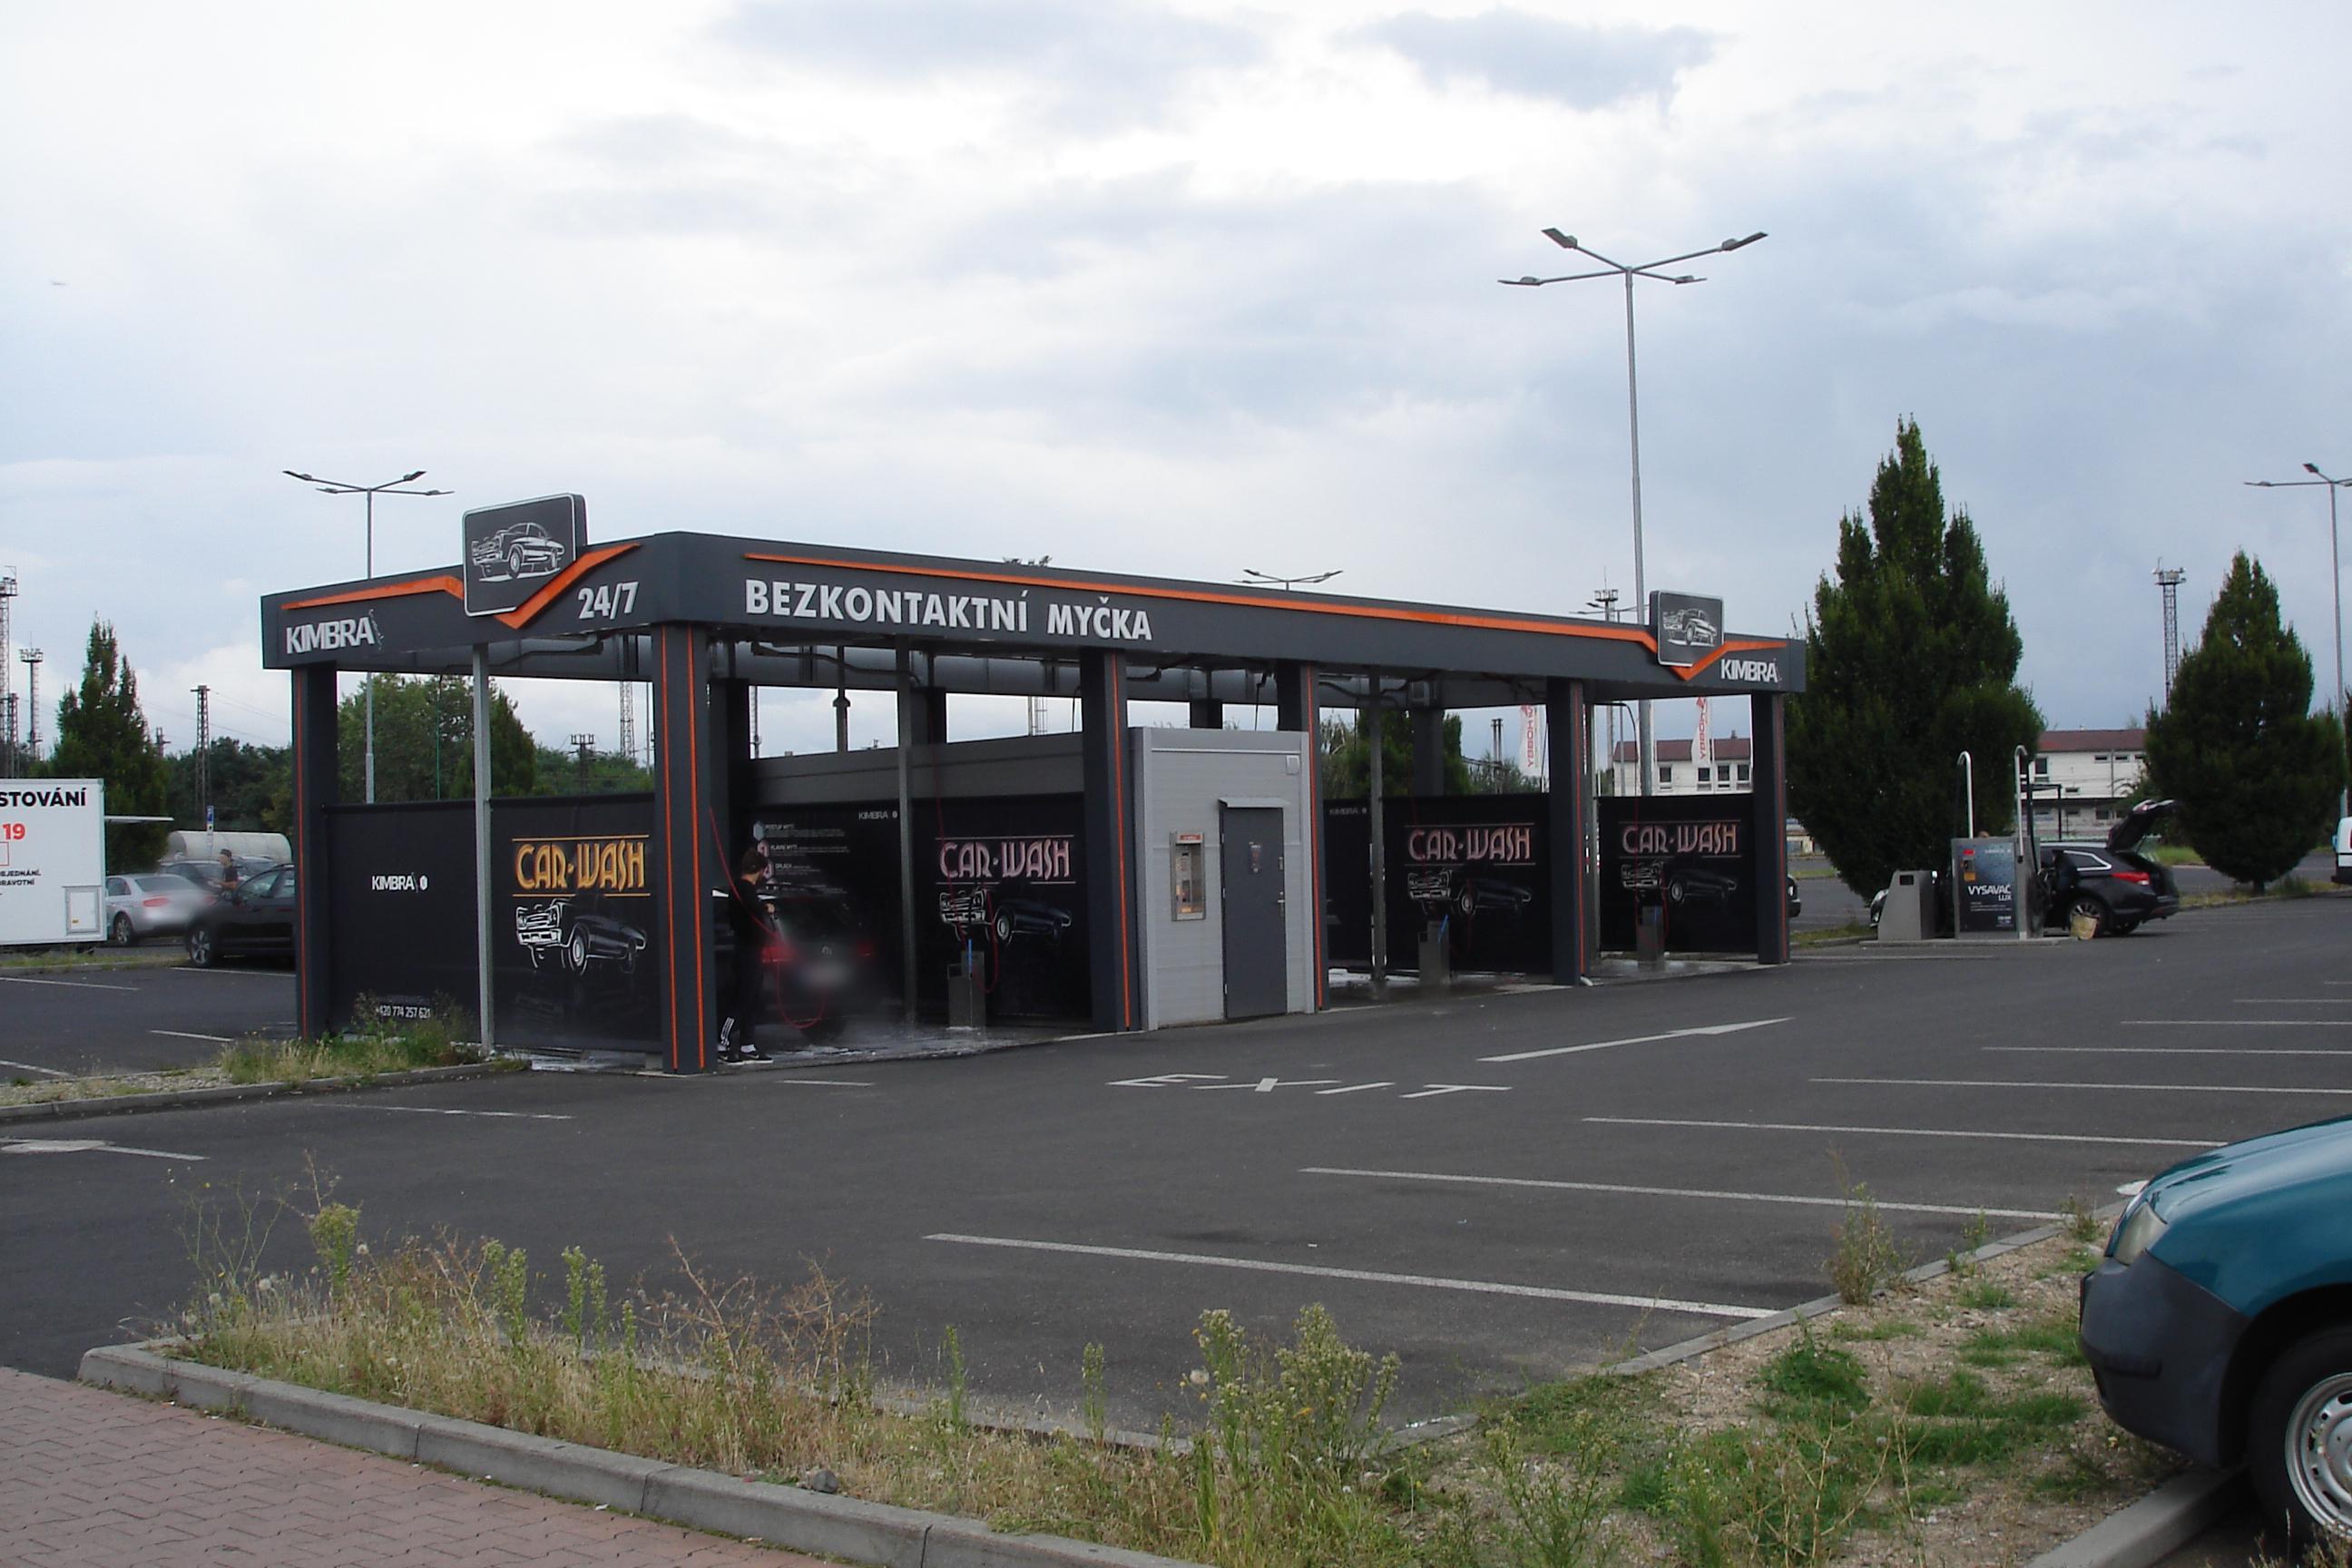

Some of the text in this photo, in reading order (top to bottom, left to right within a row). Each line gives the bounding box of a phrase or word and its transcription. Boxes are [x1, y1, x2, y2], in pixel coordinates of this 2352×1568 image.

[577, 582, 639, 620] 24/7
[745, 579, 1152, 641] BEZKONTAKTNÍ MYČKA
[286, 617, 375, 654] KIMBRA
[1720, 658, 1779, 683] KIMBRA
[0, 787, 86, 807] STOVÁNÍ
[2, 823, 25, 840] 19
[372, 875, 415, 891] KIMBRA
[1967, 884, 2012, 895] VYSAVAČ
[392, 1005, 405, 1016] 774
[405, 1005, 418, 1018] 257
